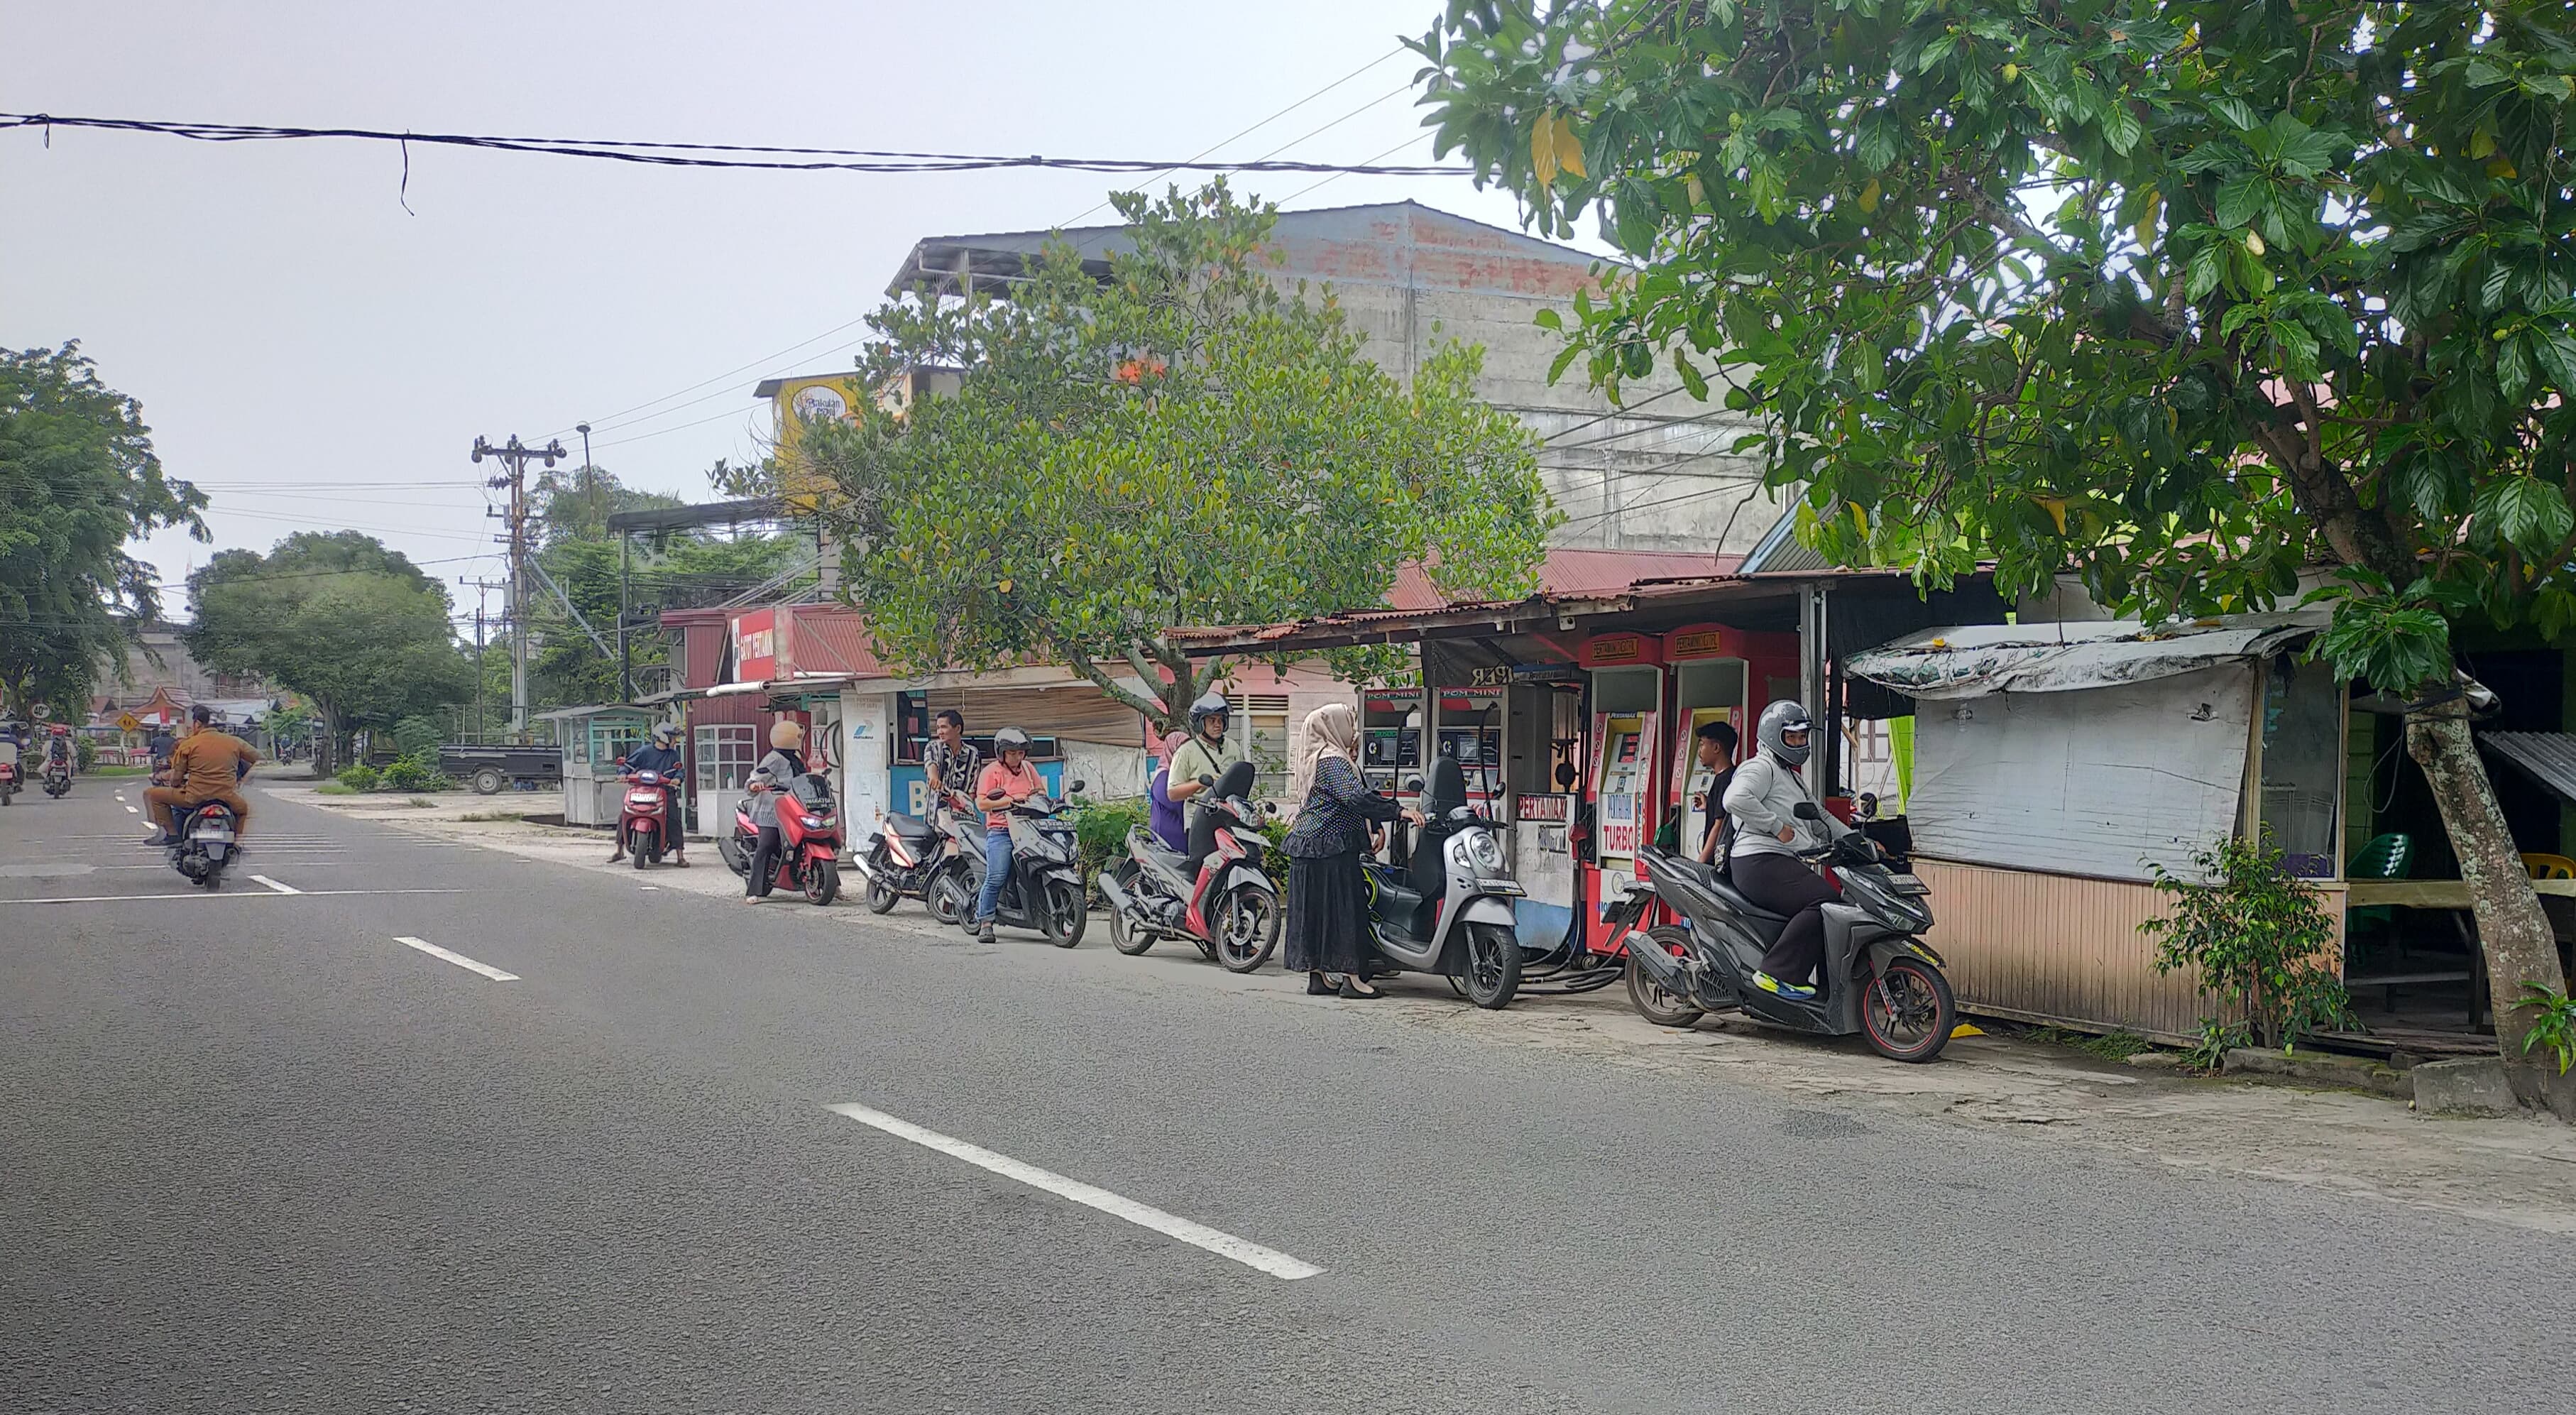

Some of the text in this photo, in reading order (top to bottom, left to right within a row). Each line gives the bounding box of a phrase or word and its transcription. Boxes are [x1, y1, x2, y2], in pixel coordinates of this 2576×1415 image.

[805, 398, 840, 410] Bakulan
[34, 706, 43, 716] 40
[1518, 794, 1565, 819] PERTAMAX
[1604, 826, 1633, 851] TURBO
